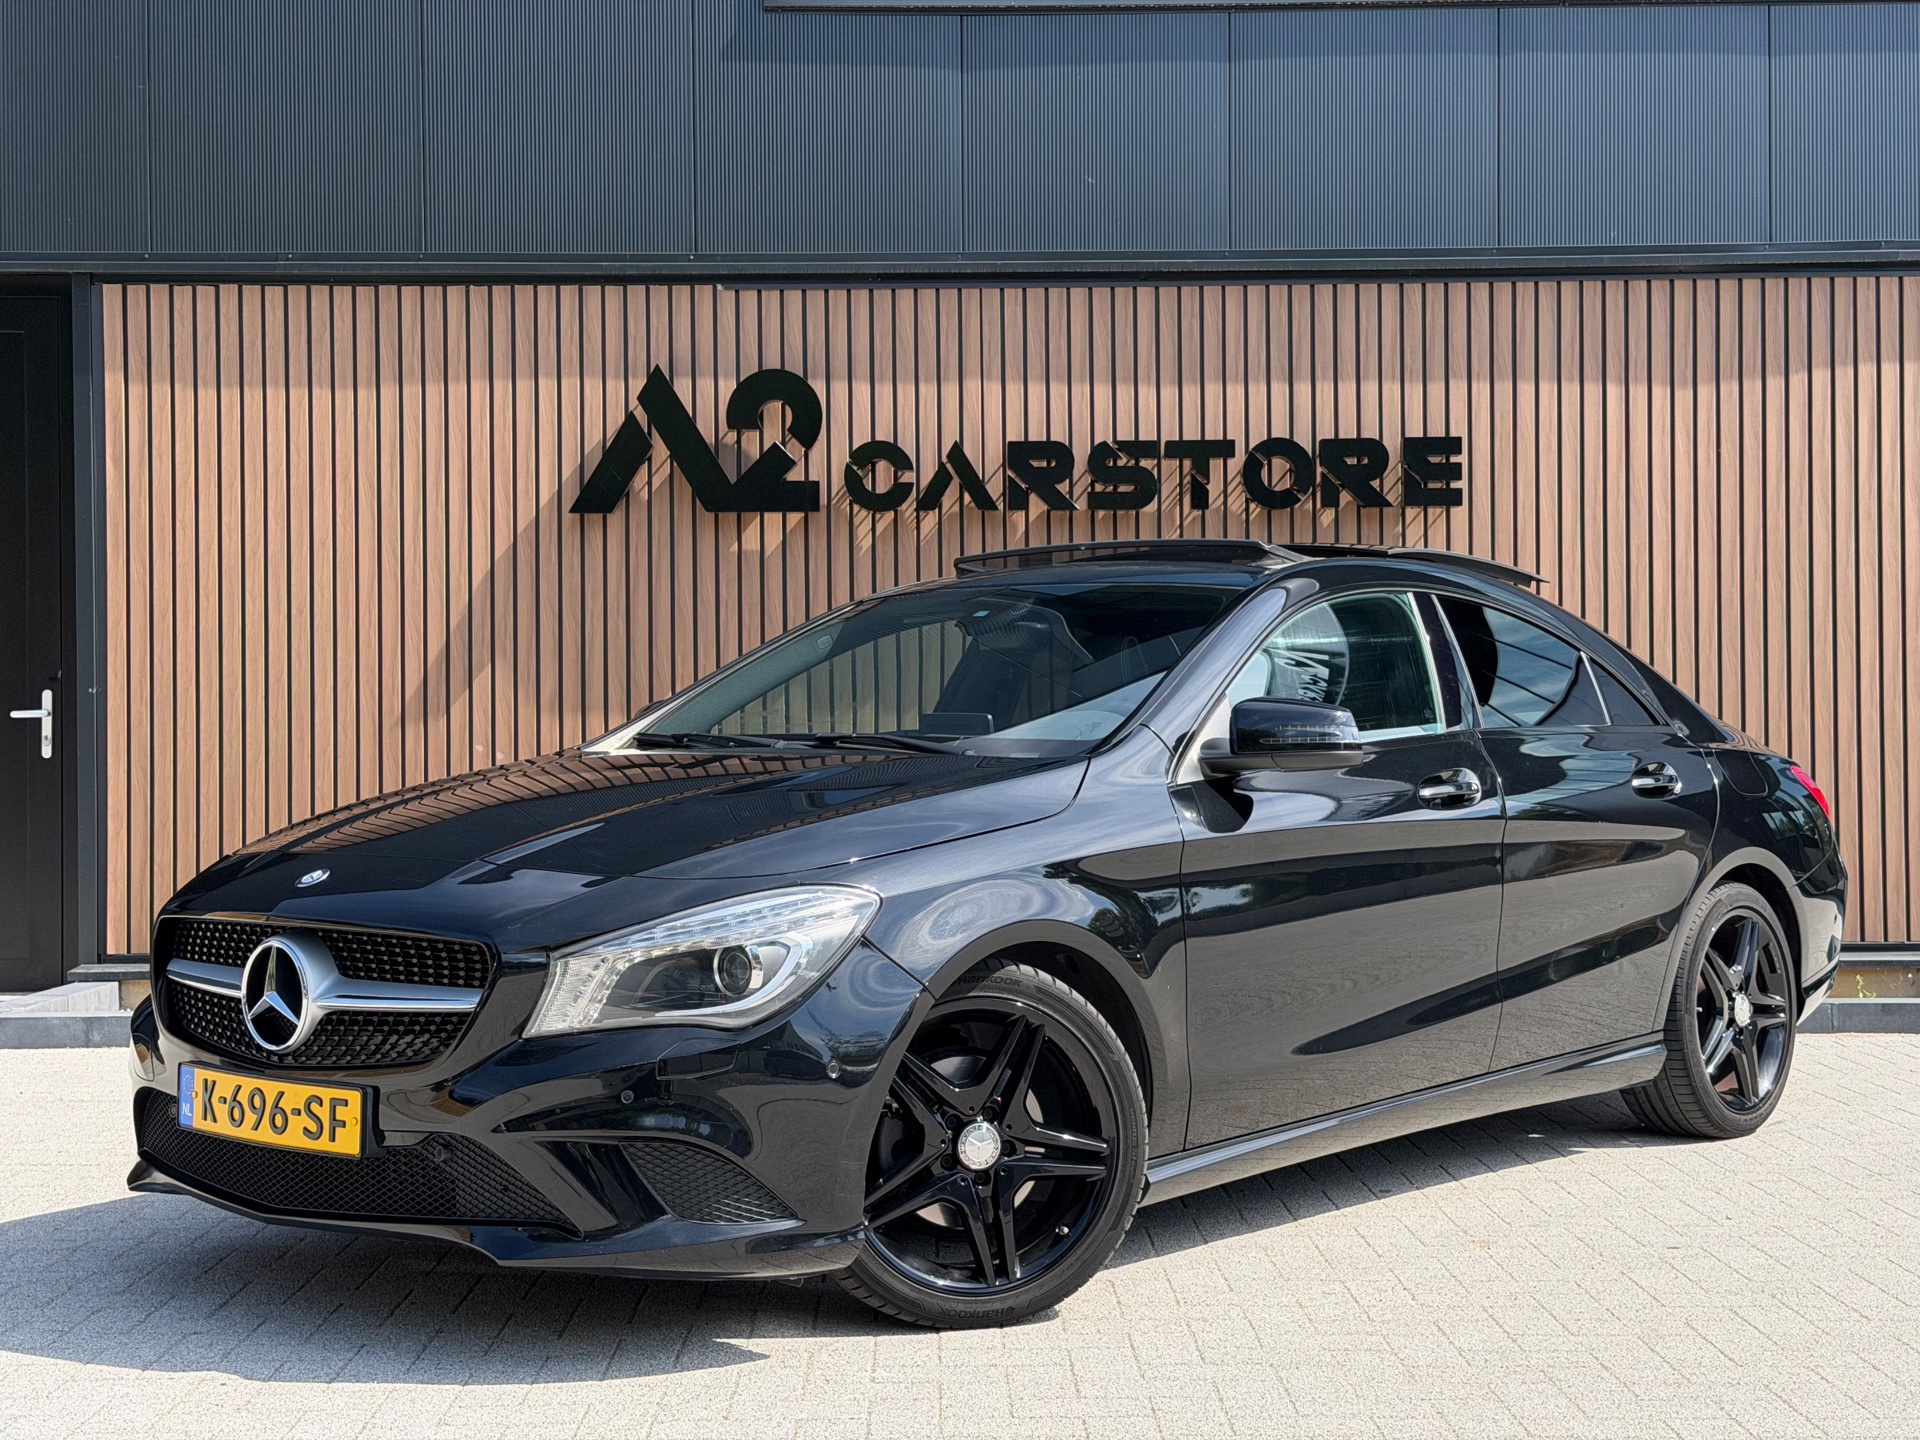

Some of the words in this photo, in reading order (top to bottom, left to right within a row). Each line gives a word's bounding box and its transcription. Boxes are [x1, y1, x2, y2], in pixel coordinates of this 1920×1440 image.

[568, 363, 823, 514] A2
[843, 436, 1463, 512] CARSTORE
[182, 1102, 192, 1117] NL
[201, 1078, 349, 1143] K-696-SF
